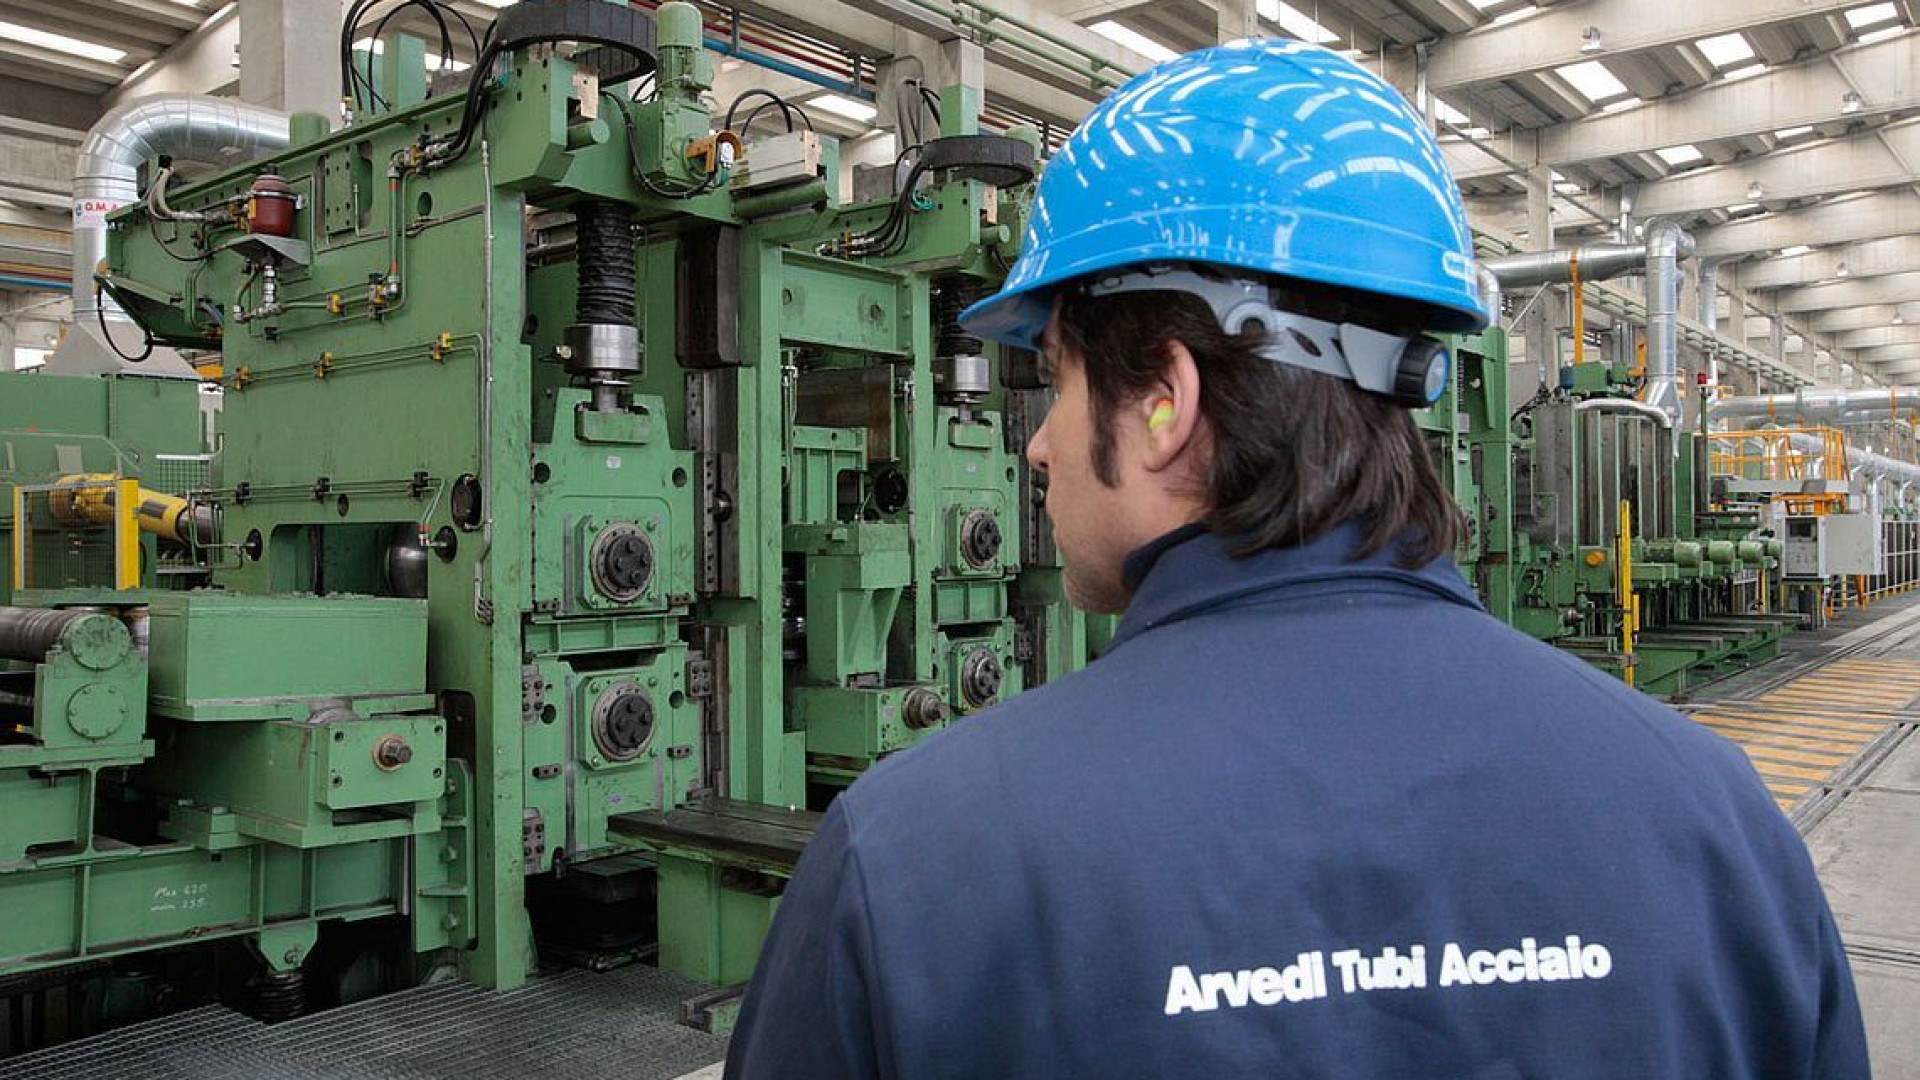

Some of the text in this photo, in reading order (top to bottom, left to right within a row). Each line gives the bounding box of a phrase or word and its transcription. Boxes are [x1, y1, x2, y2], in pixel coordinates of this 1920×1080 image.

[1164, 934, 1612, 1015] Arvedi Tubi Acciaio
